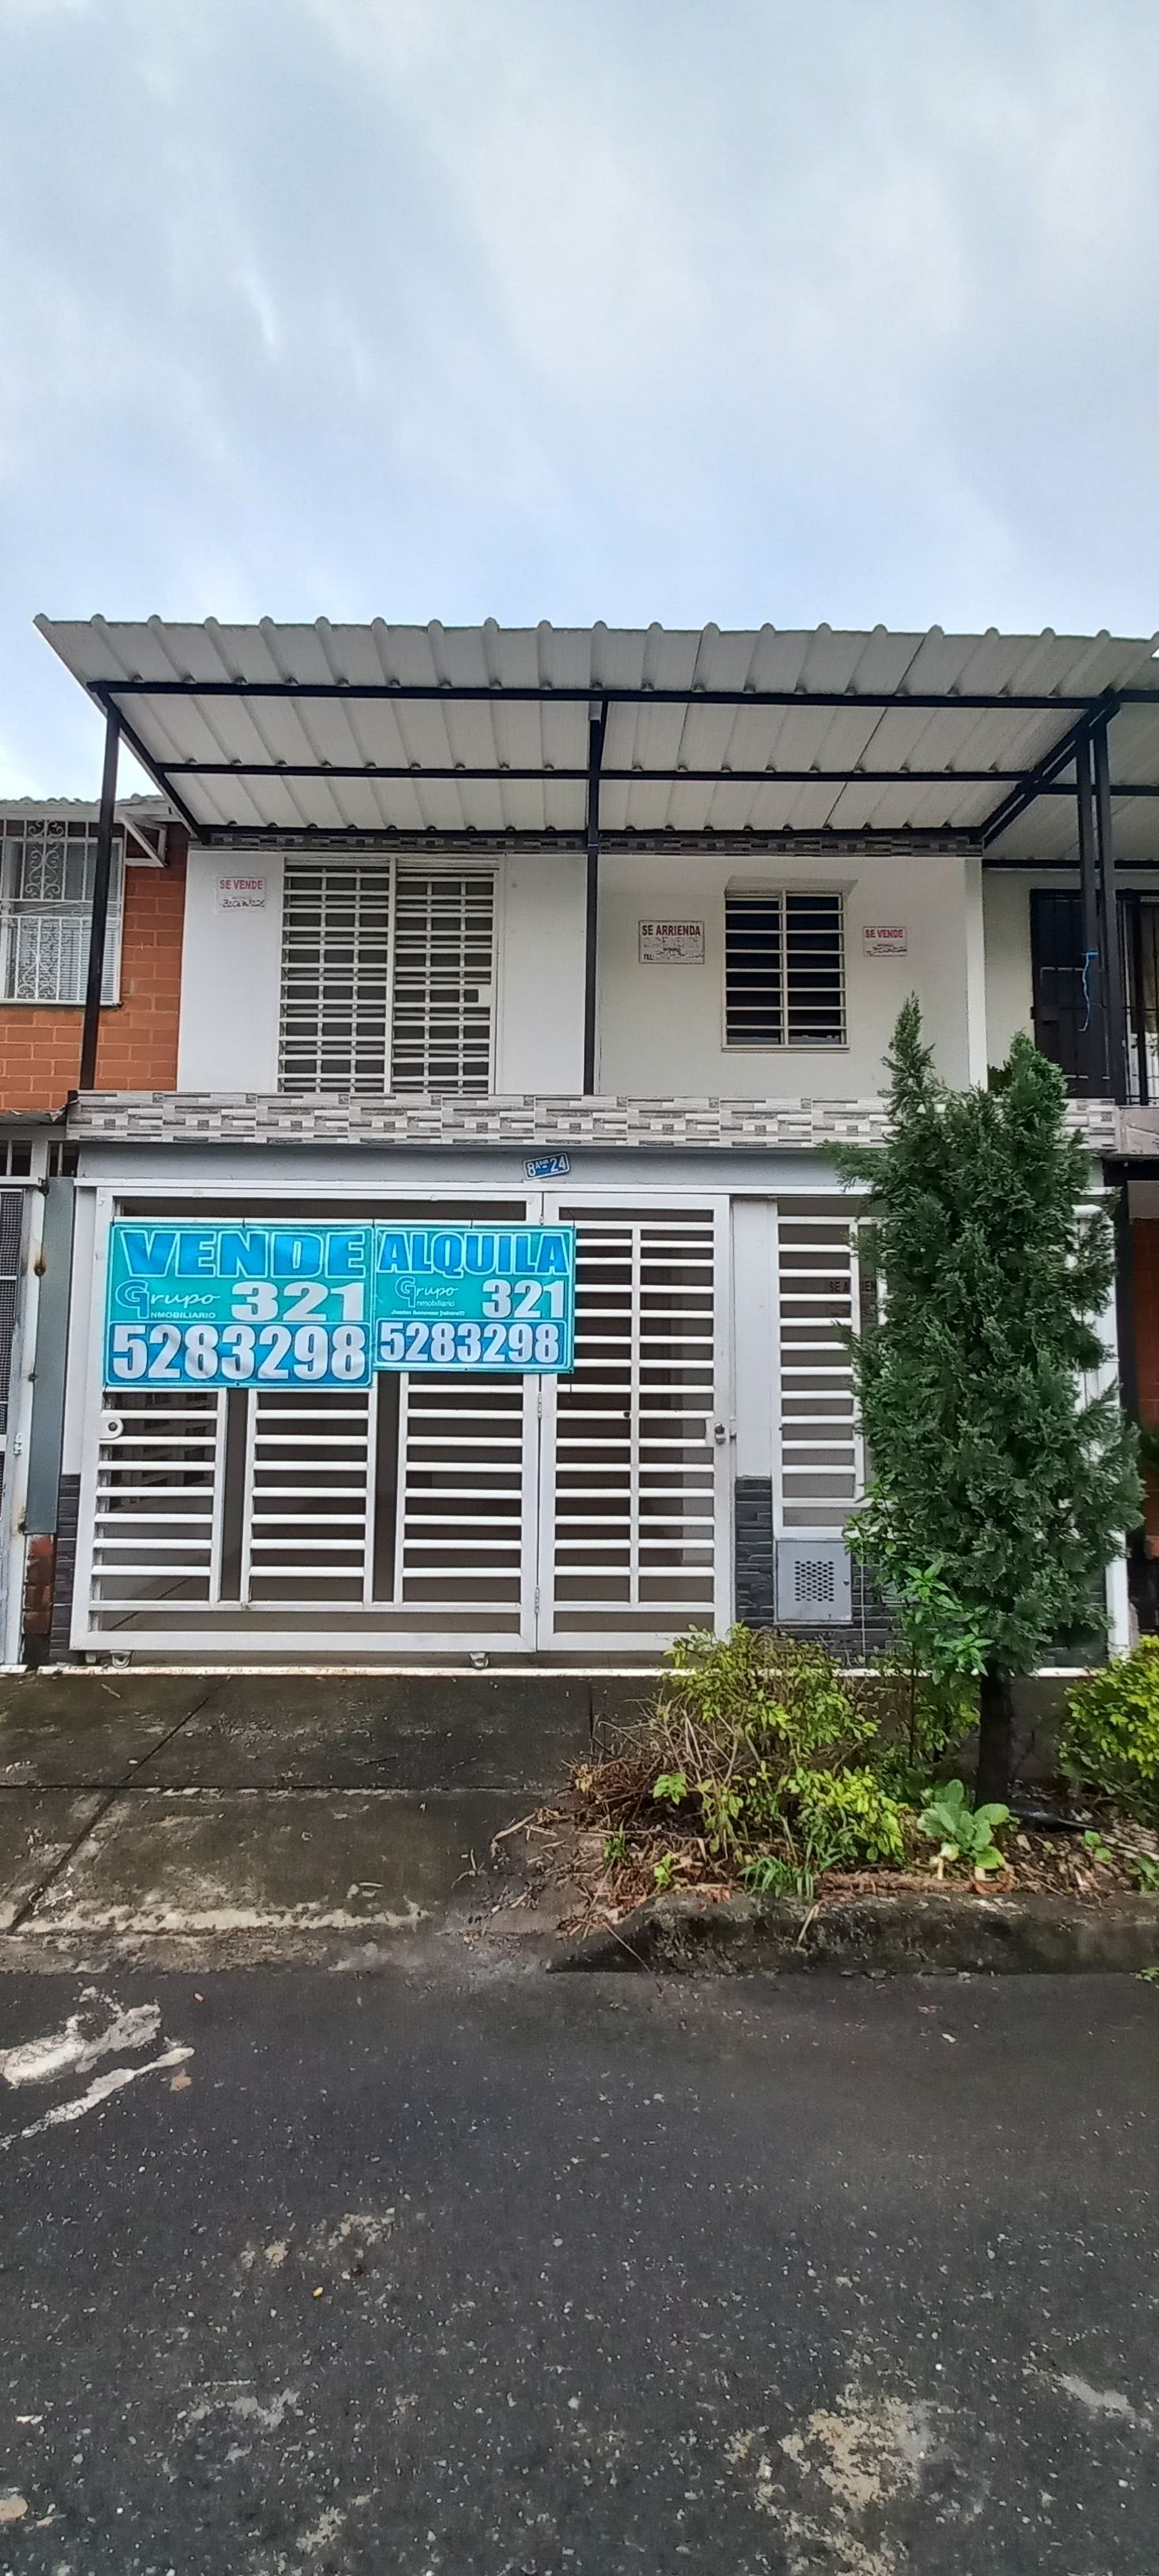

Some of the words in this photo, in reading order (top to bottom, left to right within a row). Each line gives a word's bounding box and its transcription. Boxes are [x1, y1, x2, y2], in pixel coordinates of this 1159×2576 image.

[219, 879, 231, 889] SE
[234, 879, 263, 889] VENDE
[642, 925, 654, 935] SE
[655, 925, 701, 936] ARRIENDA
[865, 929, 876, 938] SE
[877, 929, 903, 938] VENDE
[120, 1230, 366, 1279] VENDE
[377, 1232, 569, 1279] ALQUILA
[115, 1279, 221, 1309] Grupo
[231, 1281, 366, 1321] 321
[395, 1275, 459, 1299] Grupo
[482, 1279, 564, 1318] 321
[113, 1324, 366, 1380] 5283298
[380, 1322, 559, 1364] 5283298
